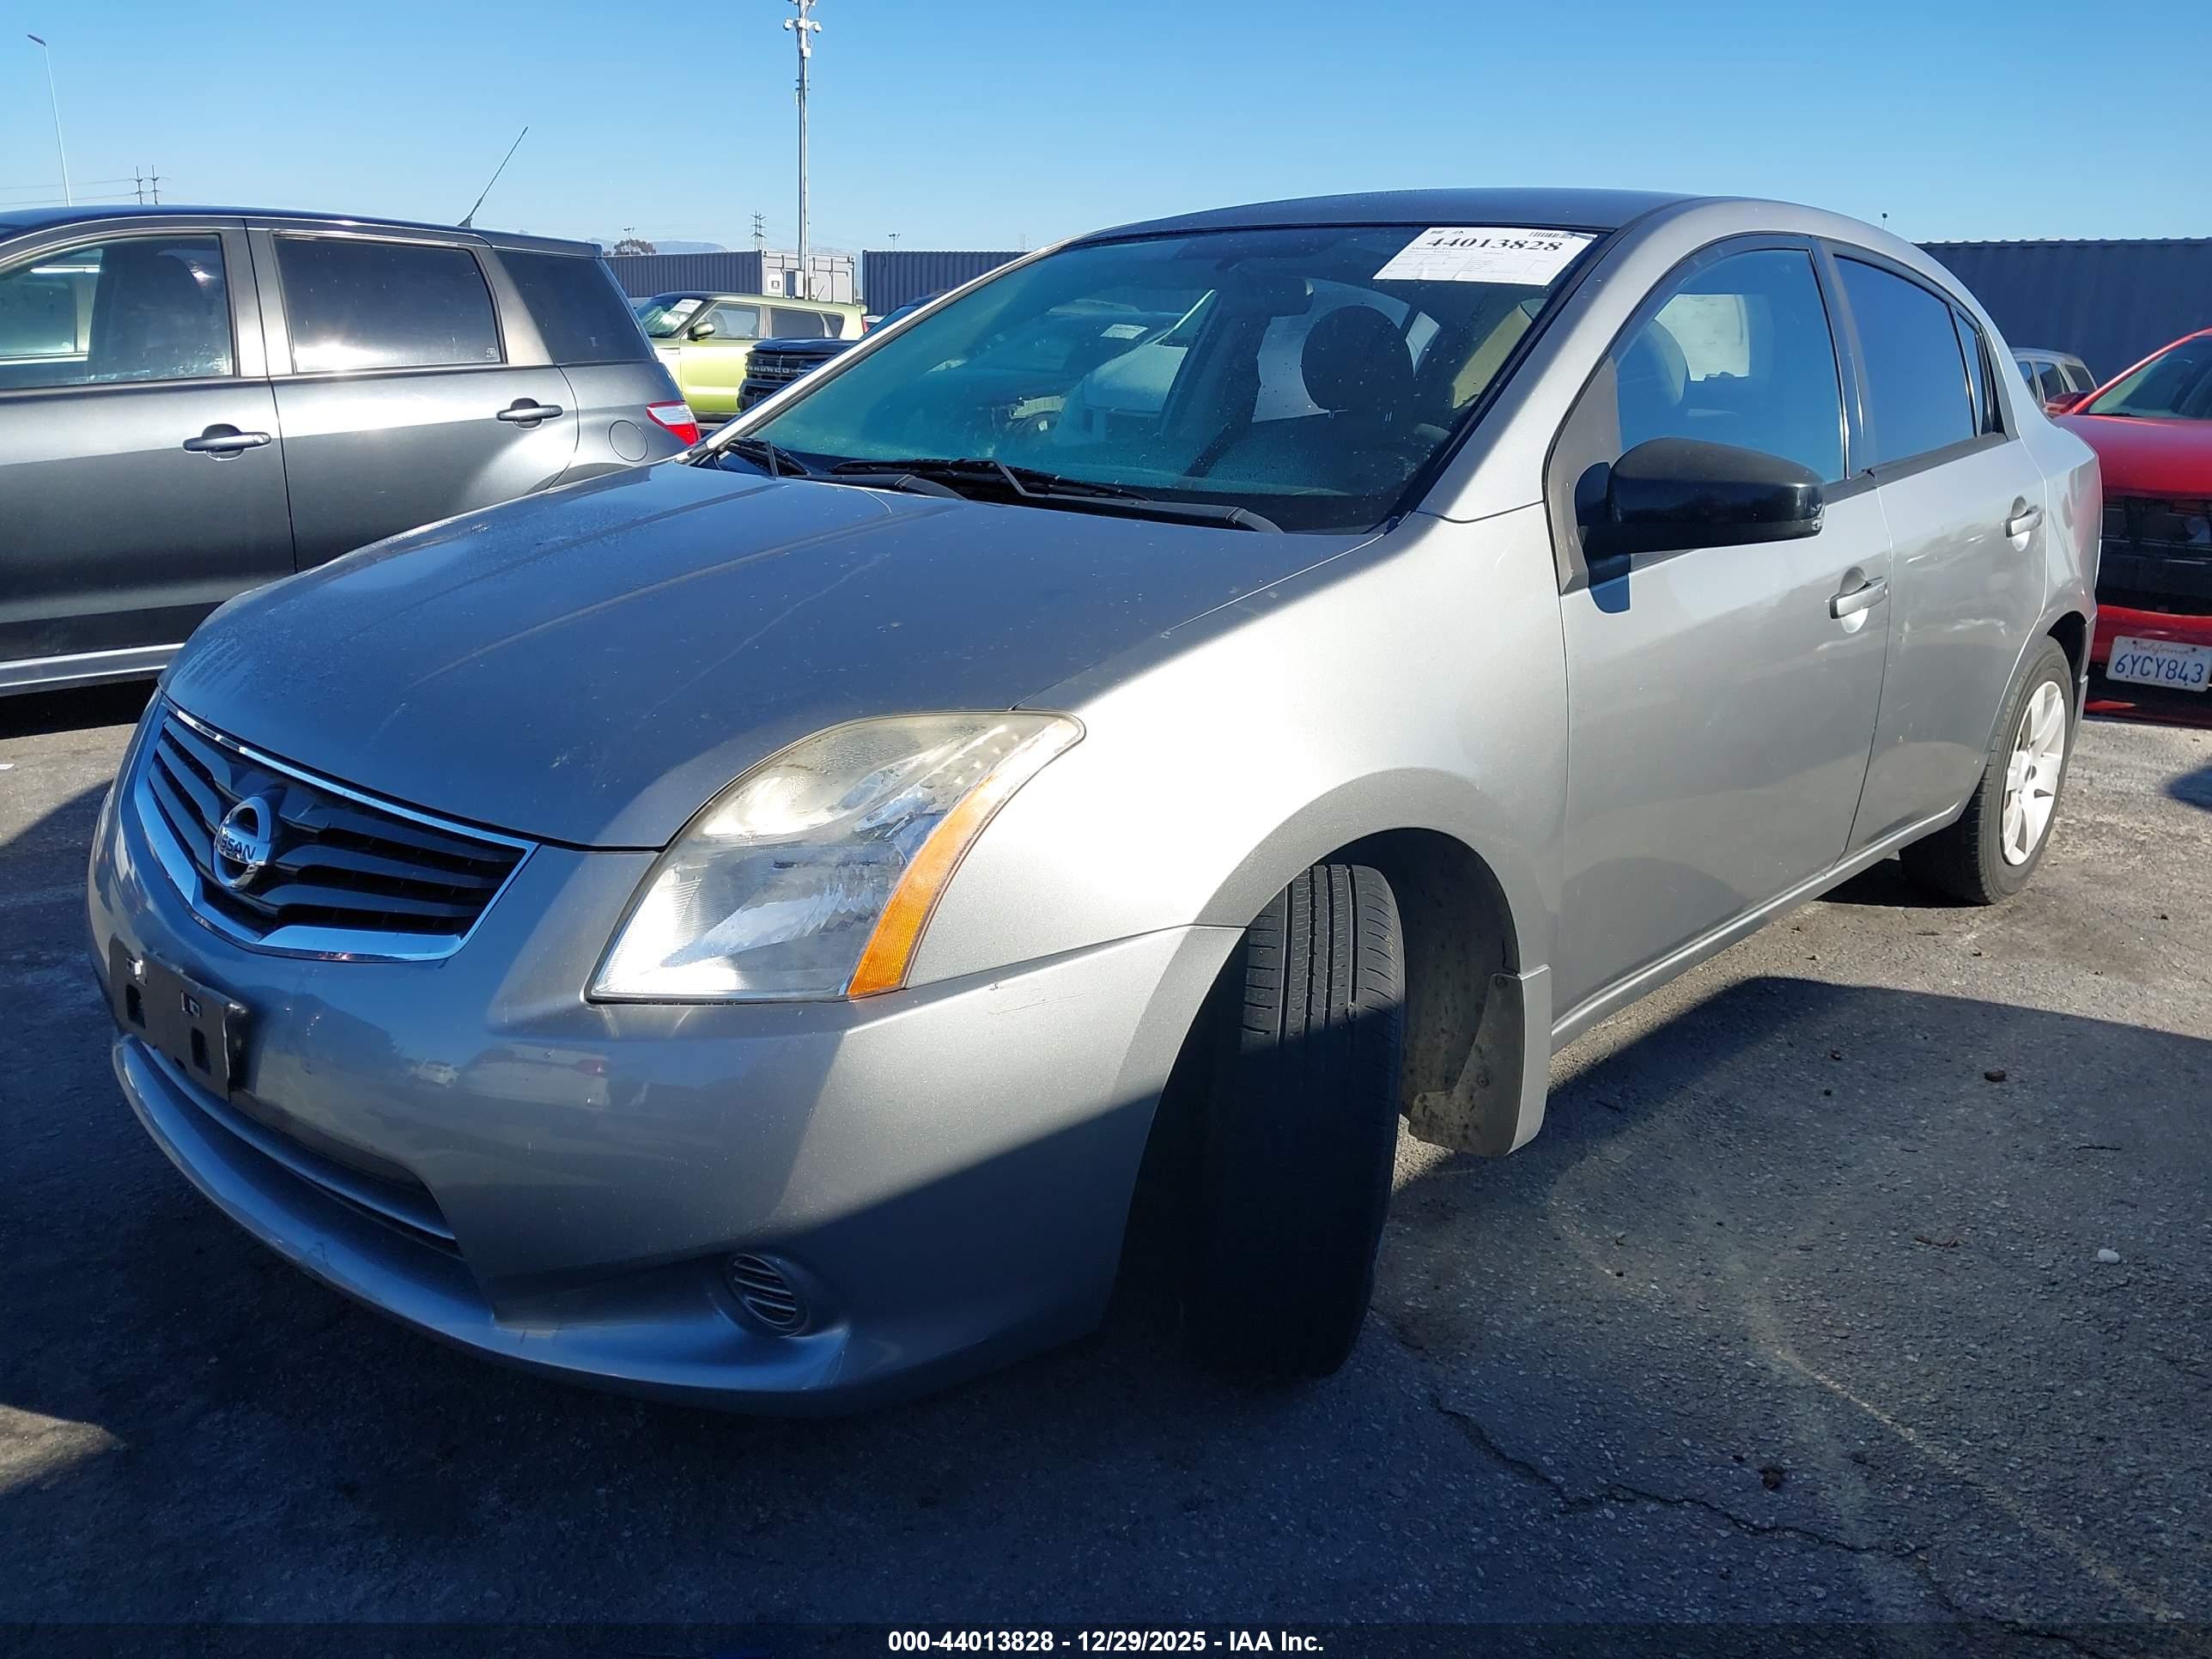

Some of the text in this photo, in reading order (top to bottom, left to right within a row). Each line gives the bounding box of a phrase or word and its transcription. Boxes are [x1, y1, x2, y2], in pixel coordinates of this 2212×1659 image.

[1425, 236, 1564, 252] 44013828
[2133, 643, 2190, 656] California
[2114, 653, 2204, 684] 6YCY843
